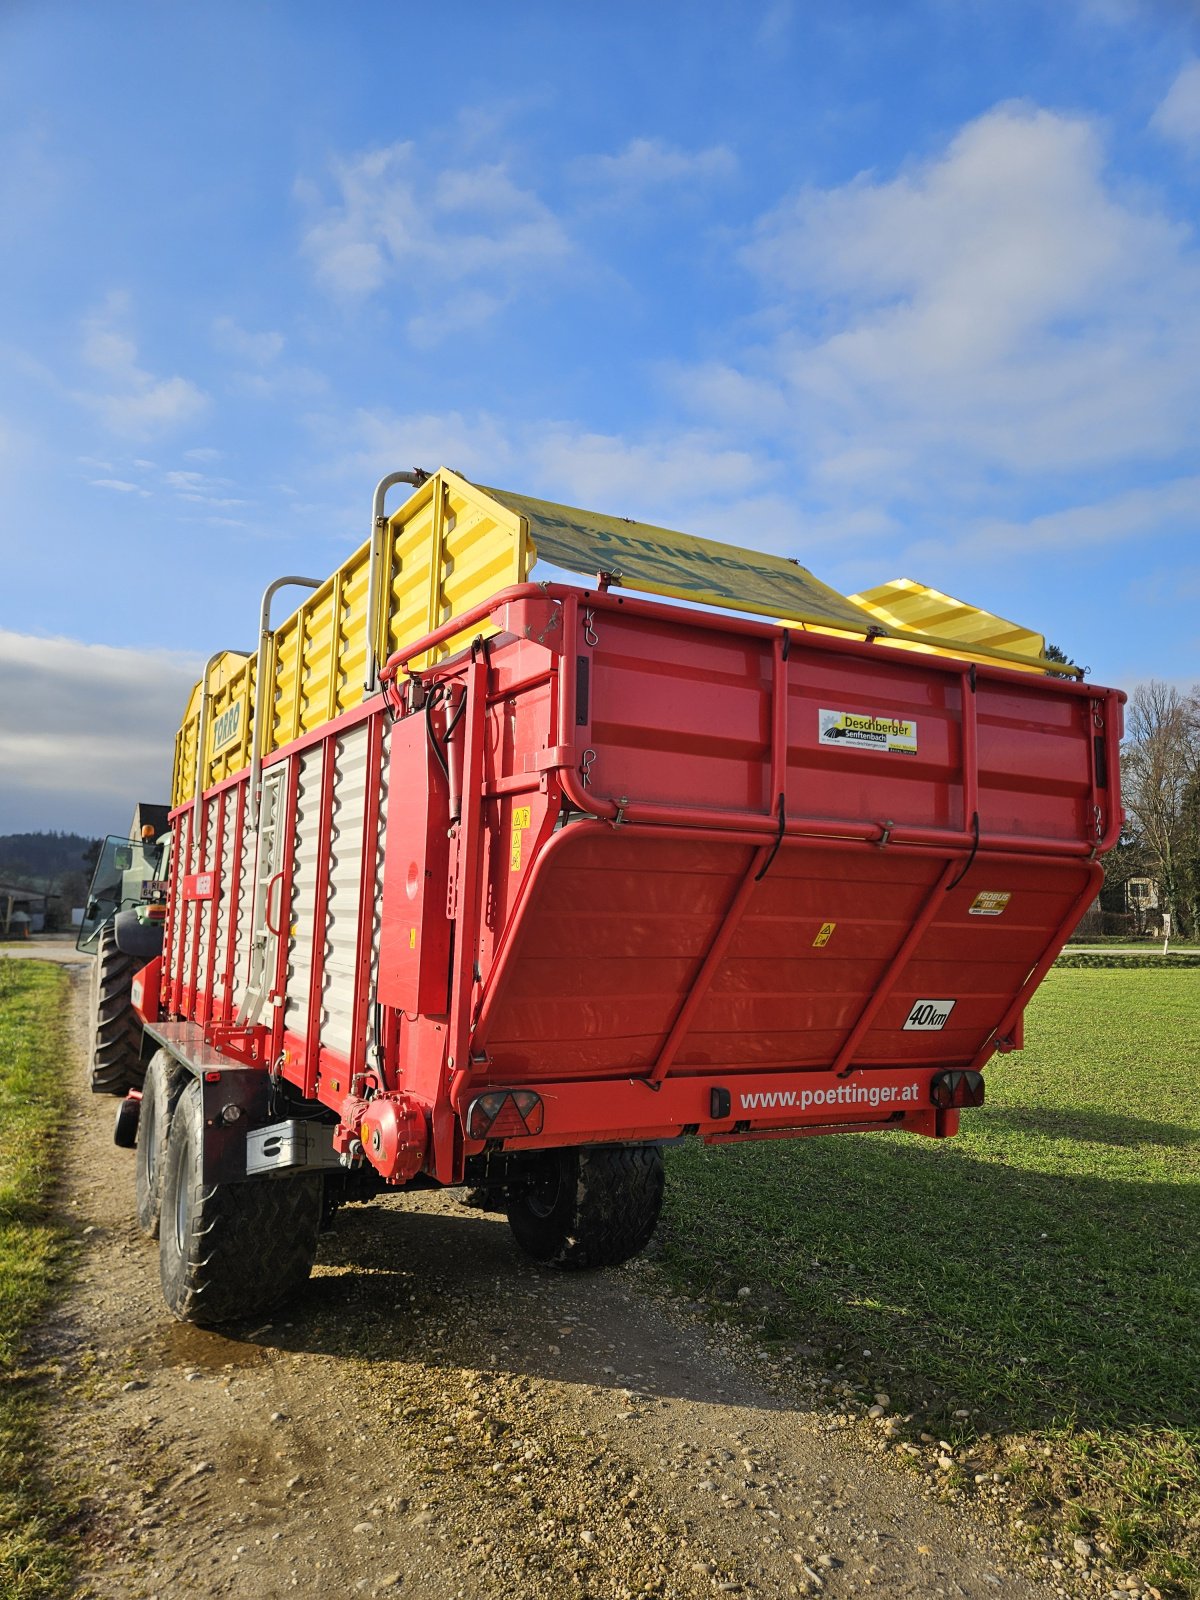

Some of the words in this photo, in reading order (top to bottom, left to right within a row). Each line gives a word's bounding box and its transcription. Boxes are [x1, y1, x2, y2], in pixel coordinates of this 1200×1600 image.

[213, 701, 240, 753] TORRO
[845, 717, 909, 736] Deschberger
[845, 730, 887, 742] Senftenbach
[978, 893, 1010, 901] ISOBUS
[740, 1083, 919, 1110] www.poettinger.at
